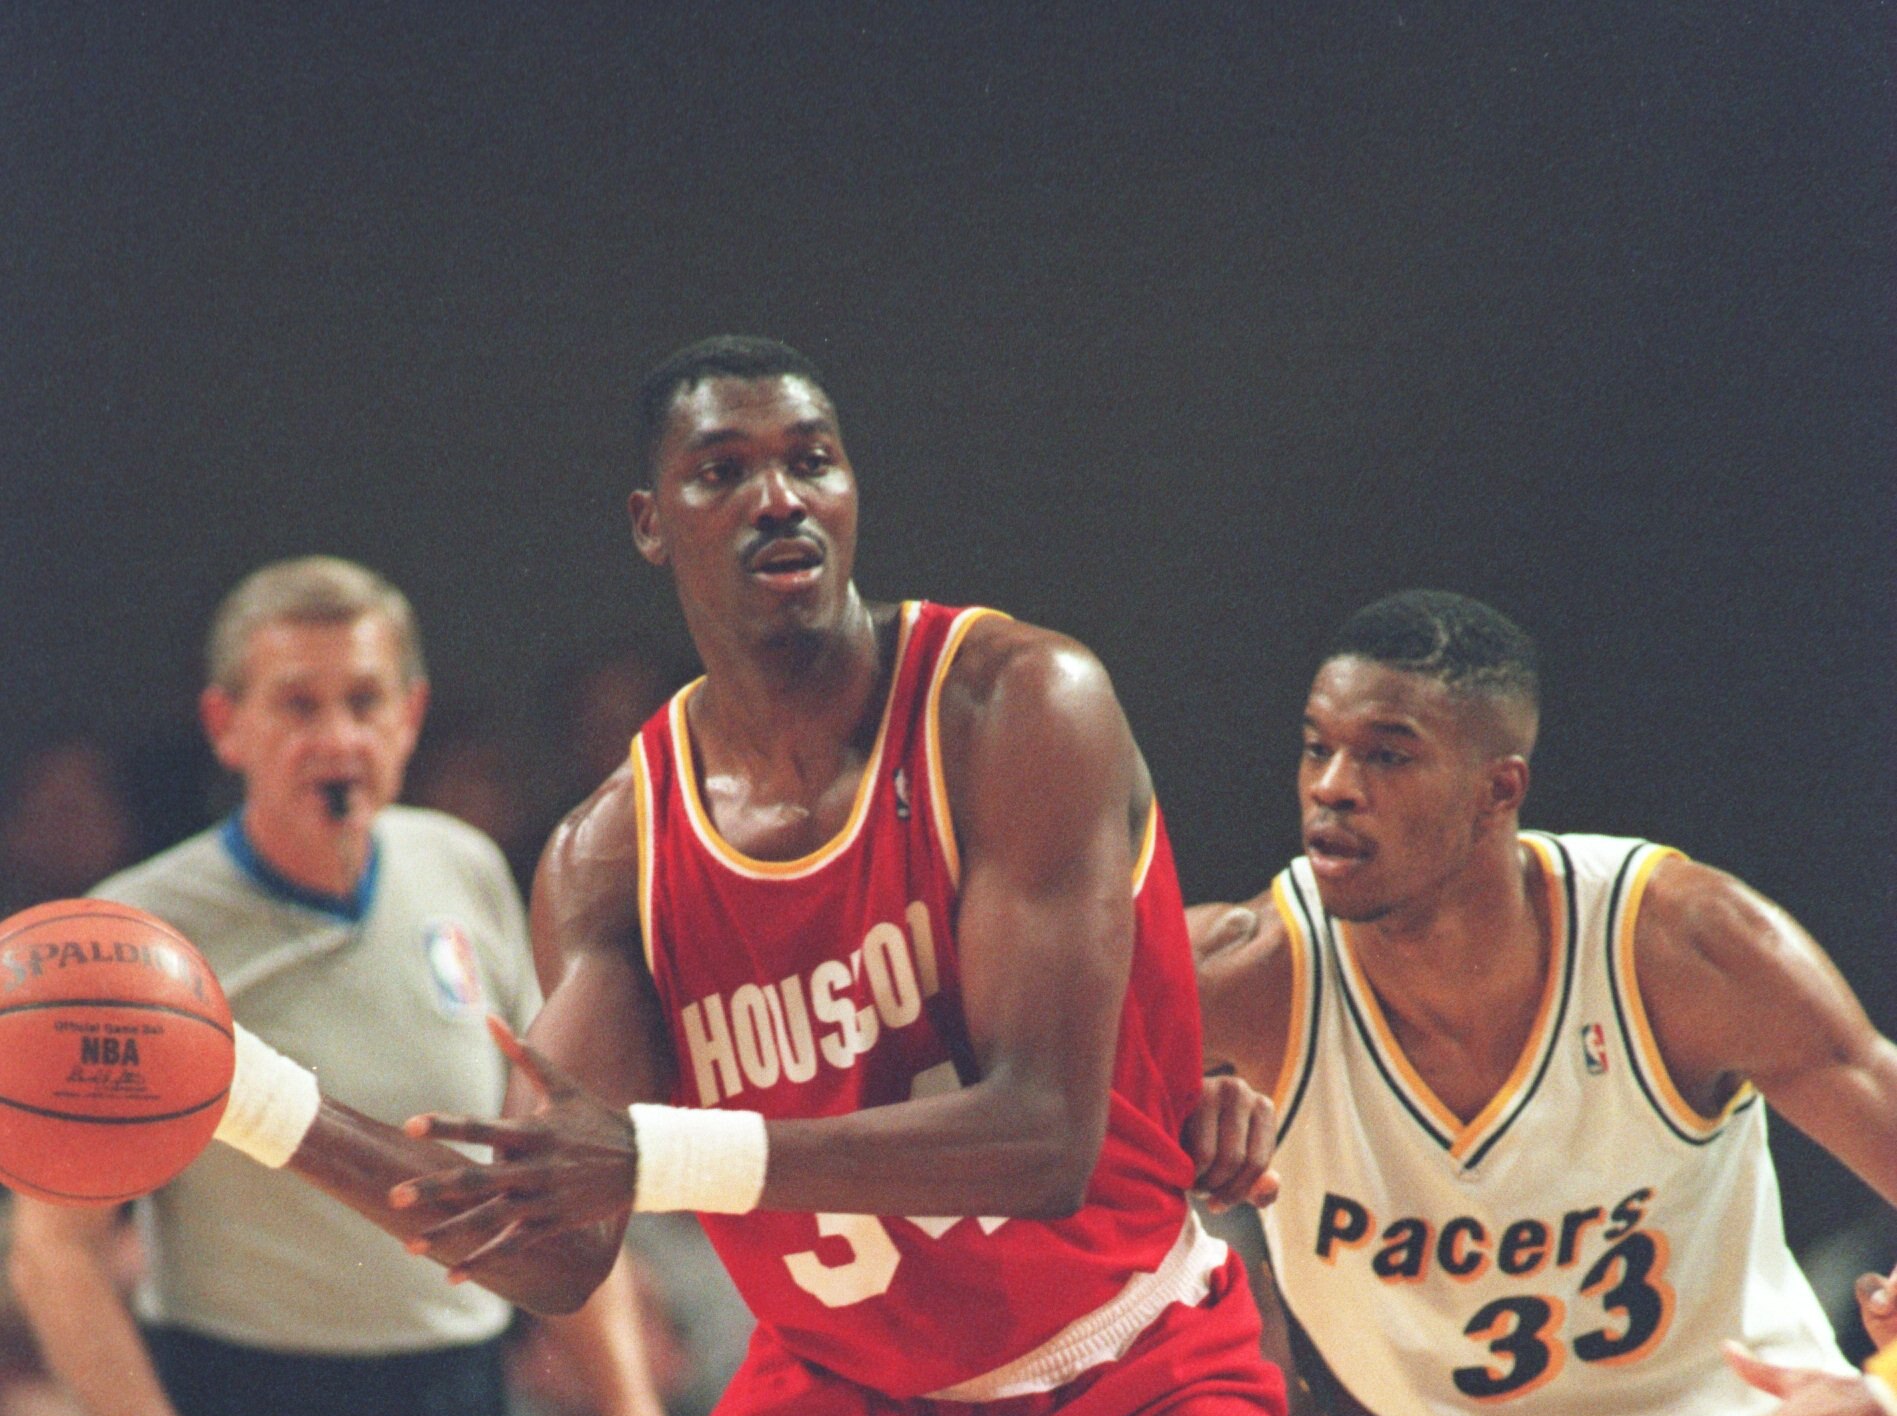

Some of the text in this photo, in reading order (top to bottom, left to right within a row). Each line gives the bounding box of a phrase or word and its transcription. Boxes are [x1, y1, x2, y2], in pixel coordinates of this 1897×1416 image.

[81, 1036, 140, 1066] NBA
[681, 901, 939, 1109] HOUSO
[1315, 1187, 1655, 1285] Pacers
[1453, 1229, 1676, 1403] 33
